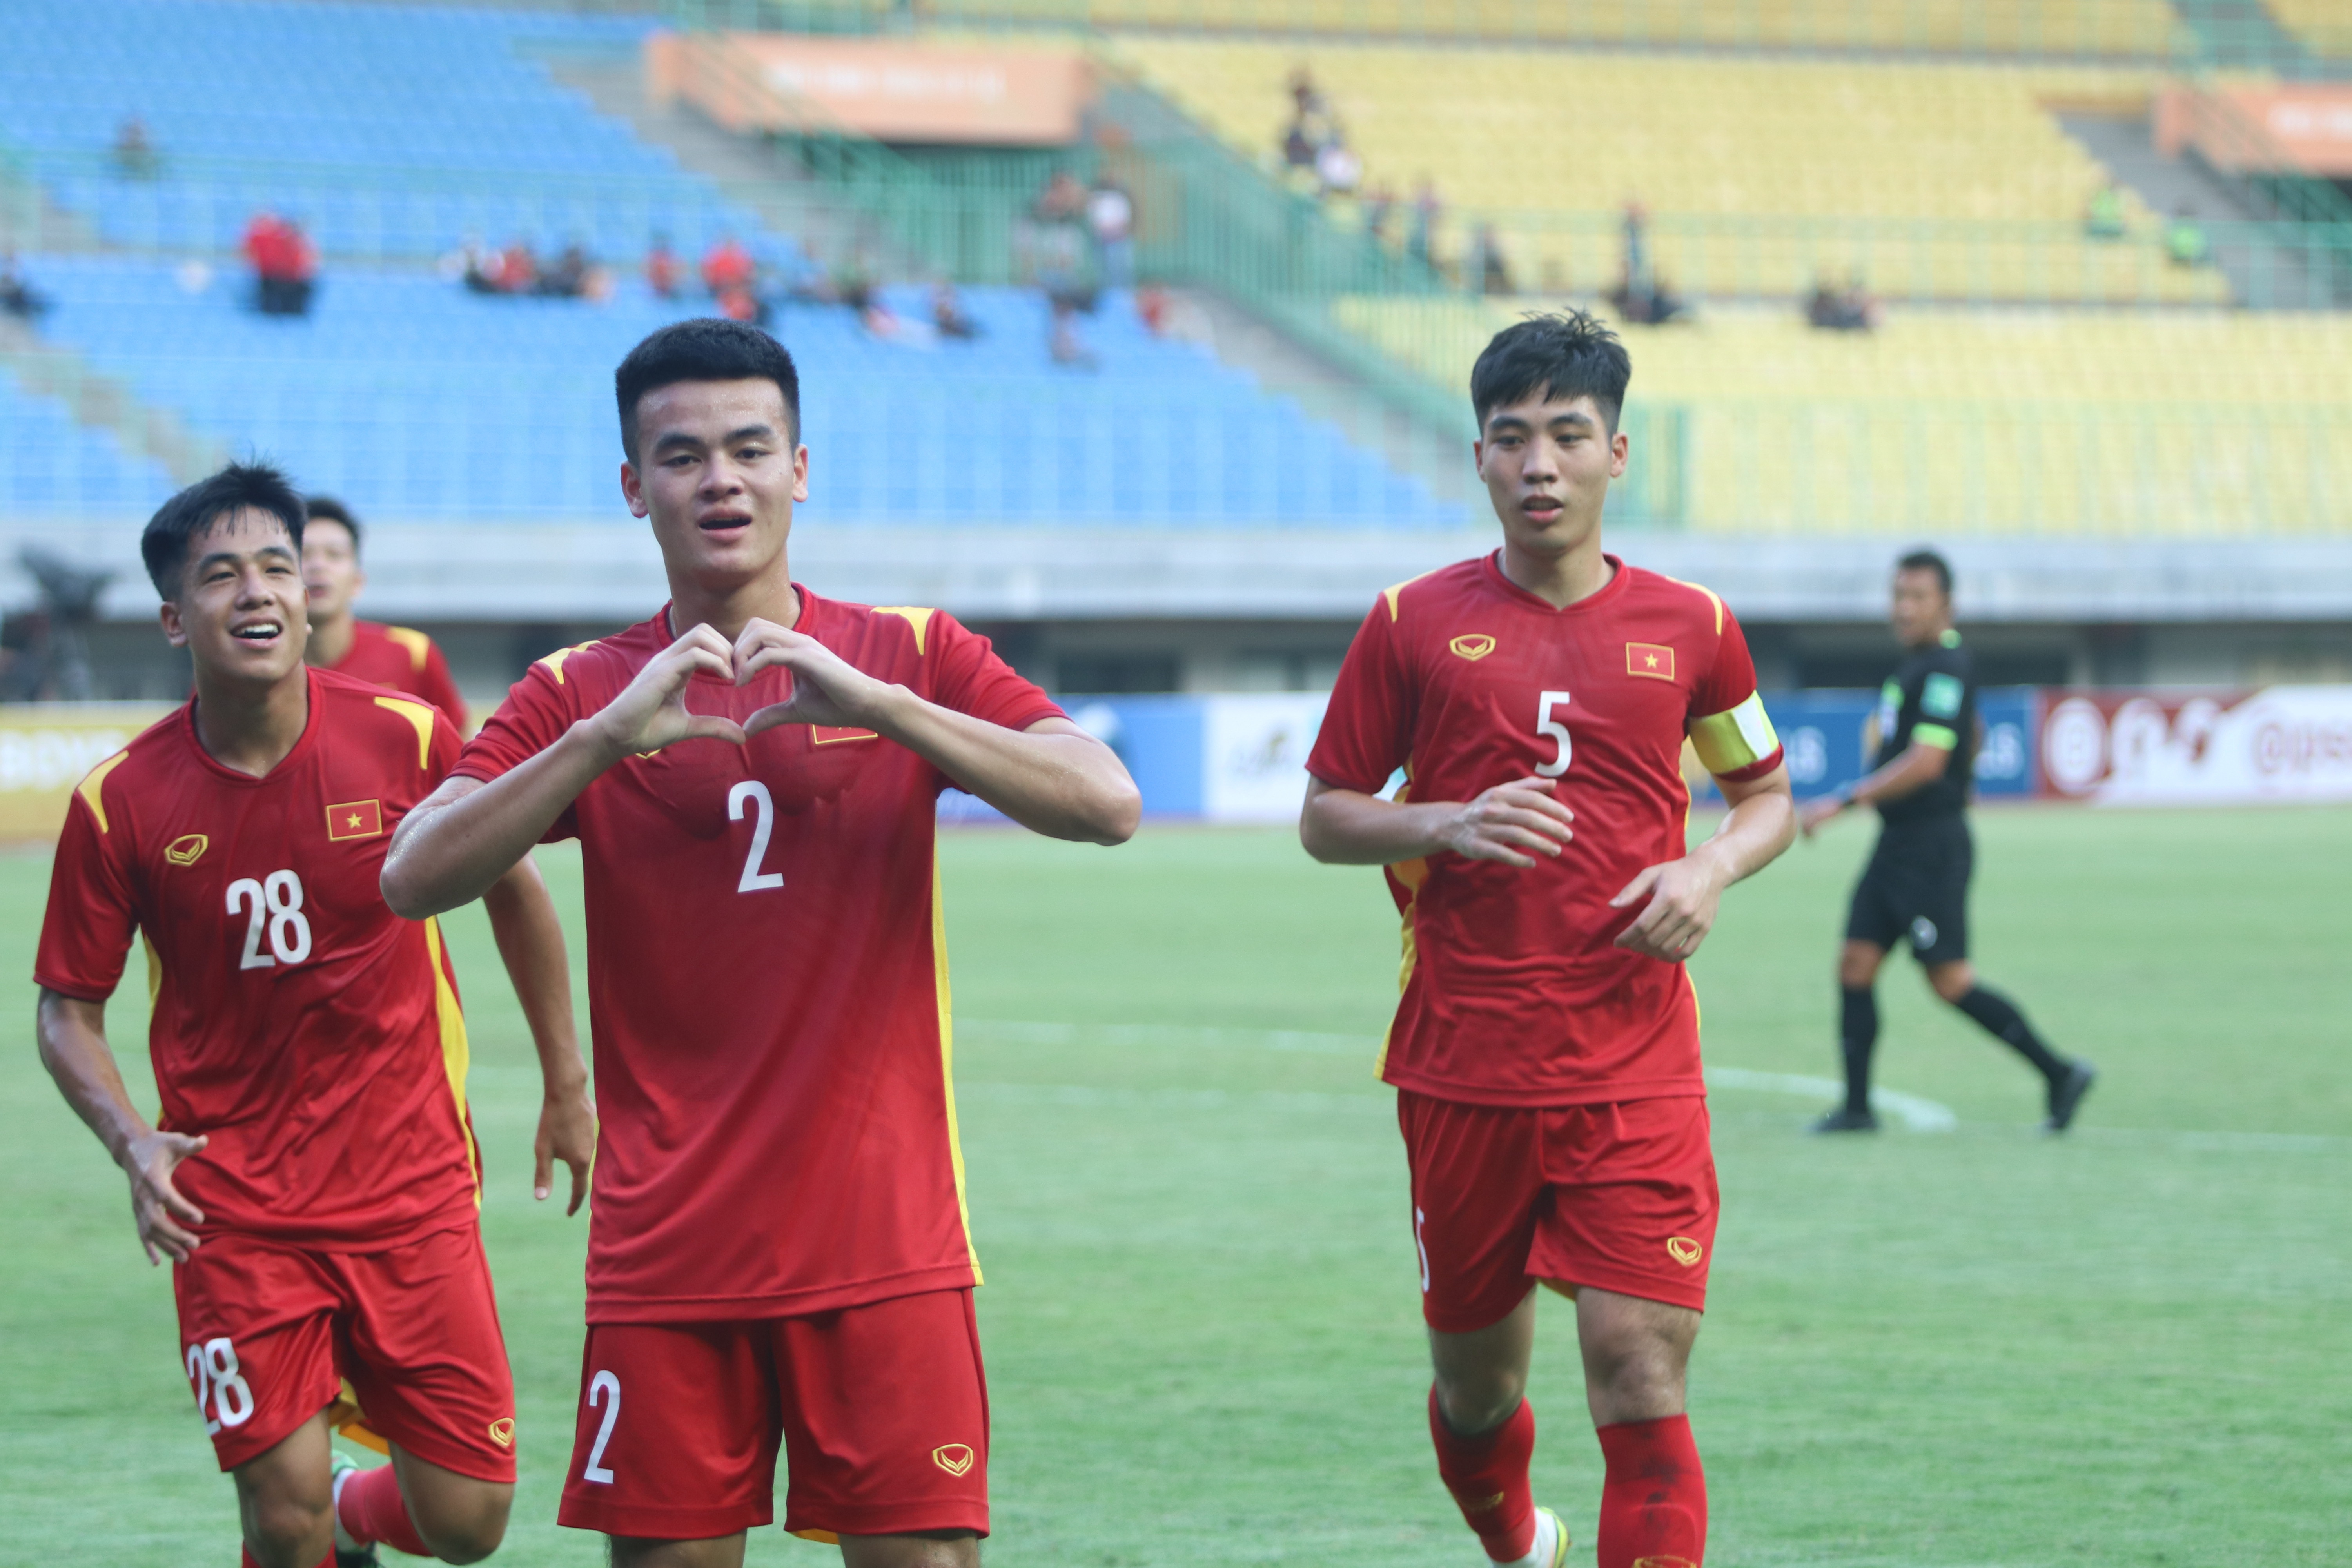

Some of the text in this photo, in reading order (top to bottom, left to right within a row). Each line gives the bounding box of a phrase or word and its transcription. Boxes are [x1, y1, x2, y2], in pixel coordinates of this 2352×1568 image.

[1535, 690, 1572, 777] 5
[728, 780, 784, 893] 2
[225, 869, 312, 970] 28
[187, 1337, 254, 1437] 28
[584, 1370, 621, 1483] 2
